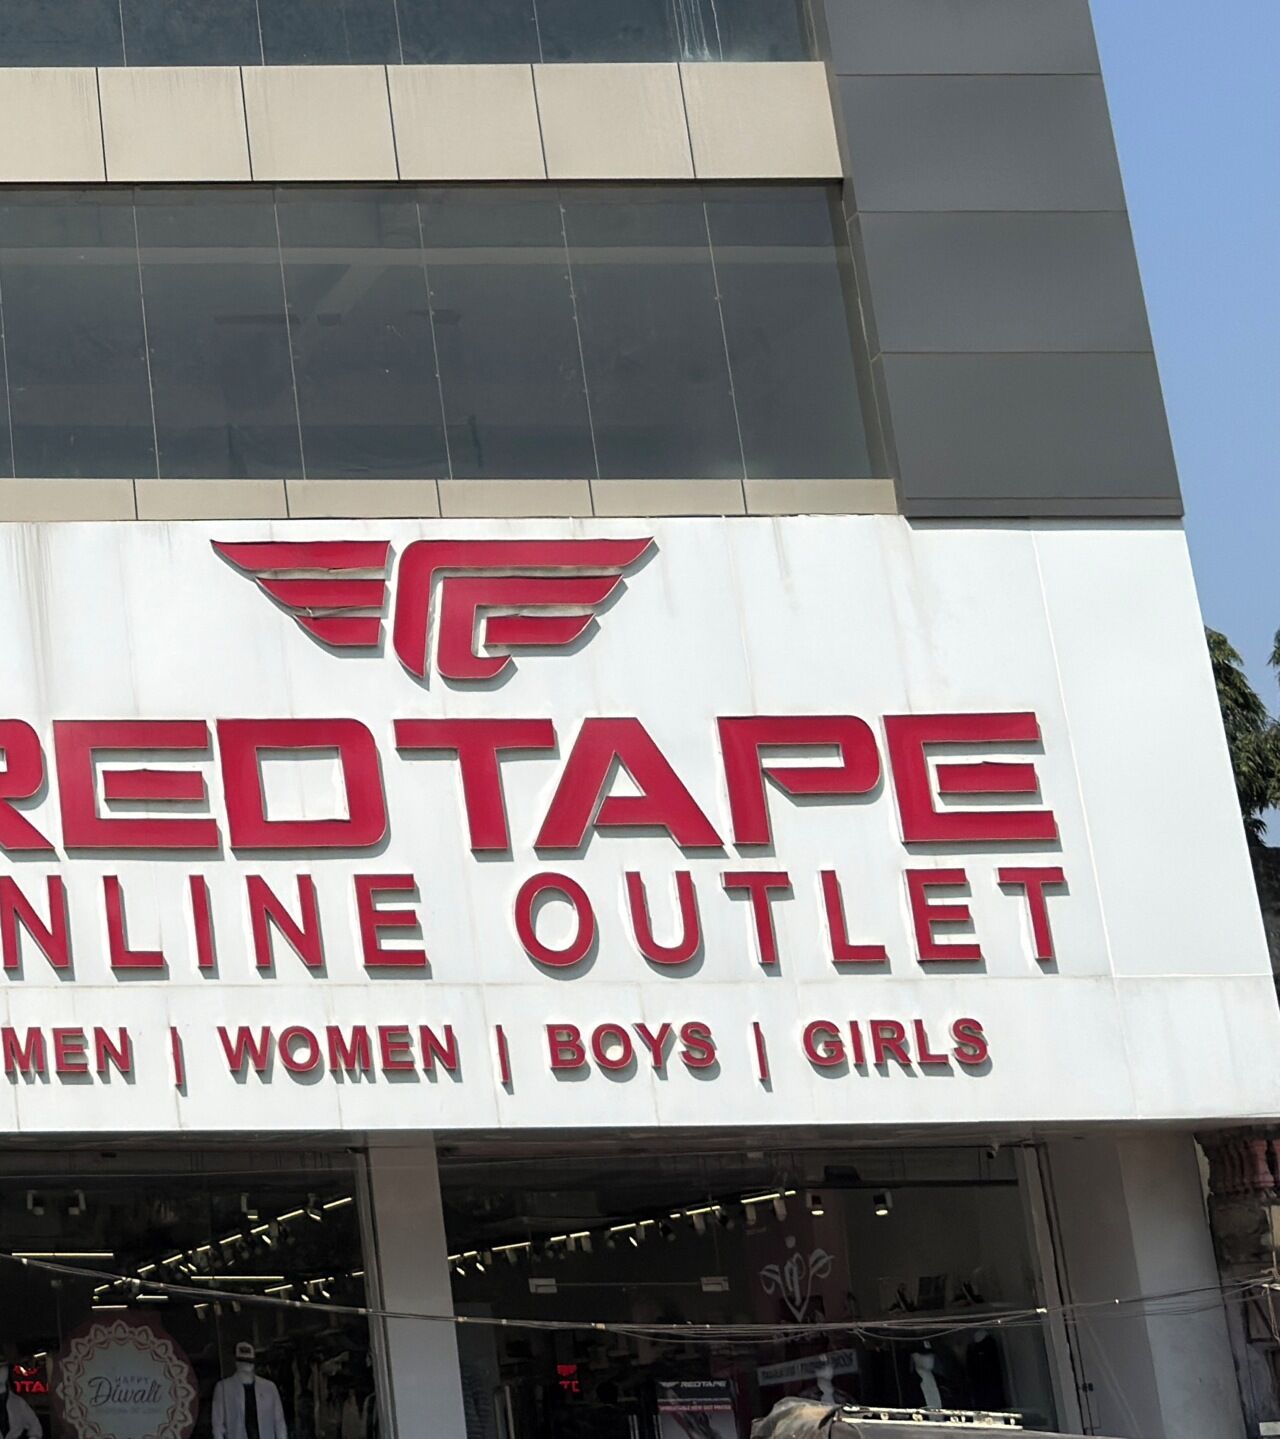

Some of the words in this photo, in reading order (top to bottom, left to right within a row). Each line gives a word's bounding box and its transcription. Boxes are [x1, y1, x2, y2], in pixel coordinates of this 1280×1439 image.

[515, 866, 1065, 966] OUTLET
[0, 1025, 131, 1074] MEN
[217, 1024, 458, 1072] WOMEN
[546, 1021, 717, 1070] BOYS
[802, 1018, 990, 1067] GIRLS
[88, 1376, 162, 1407] Diwali
